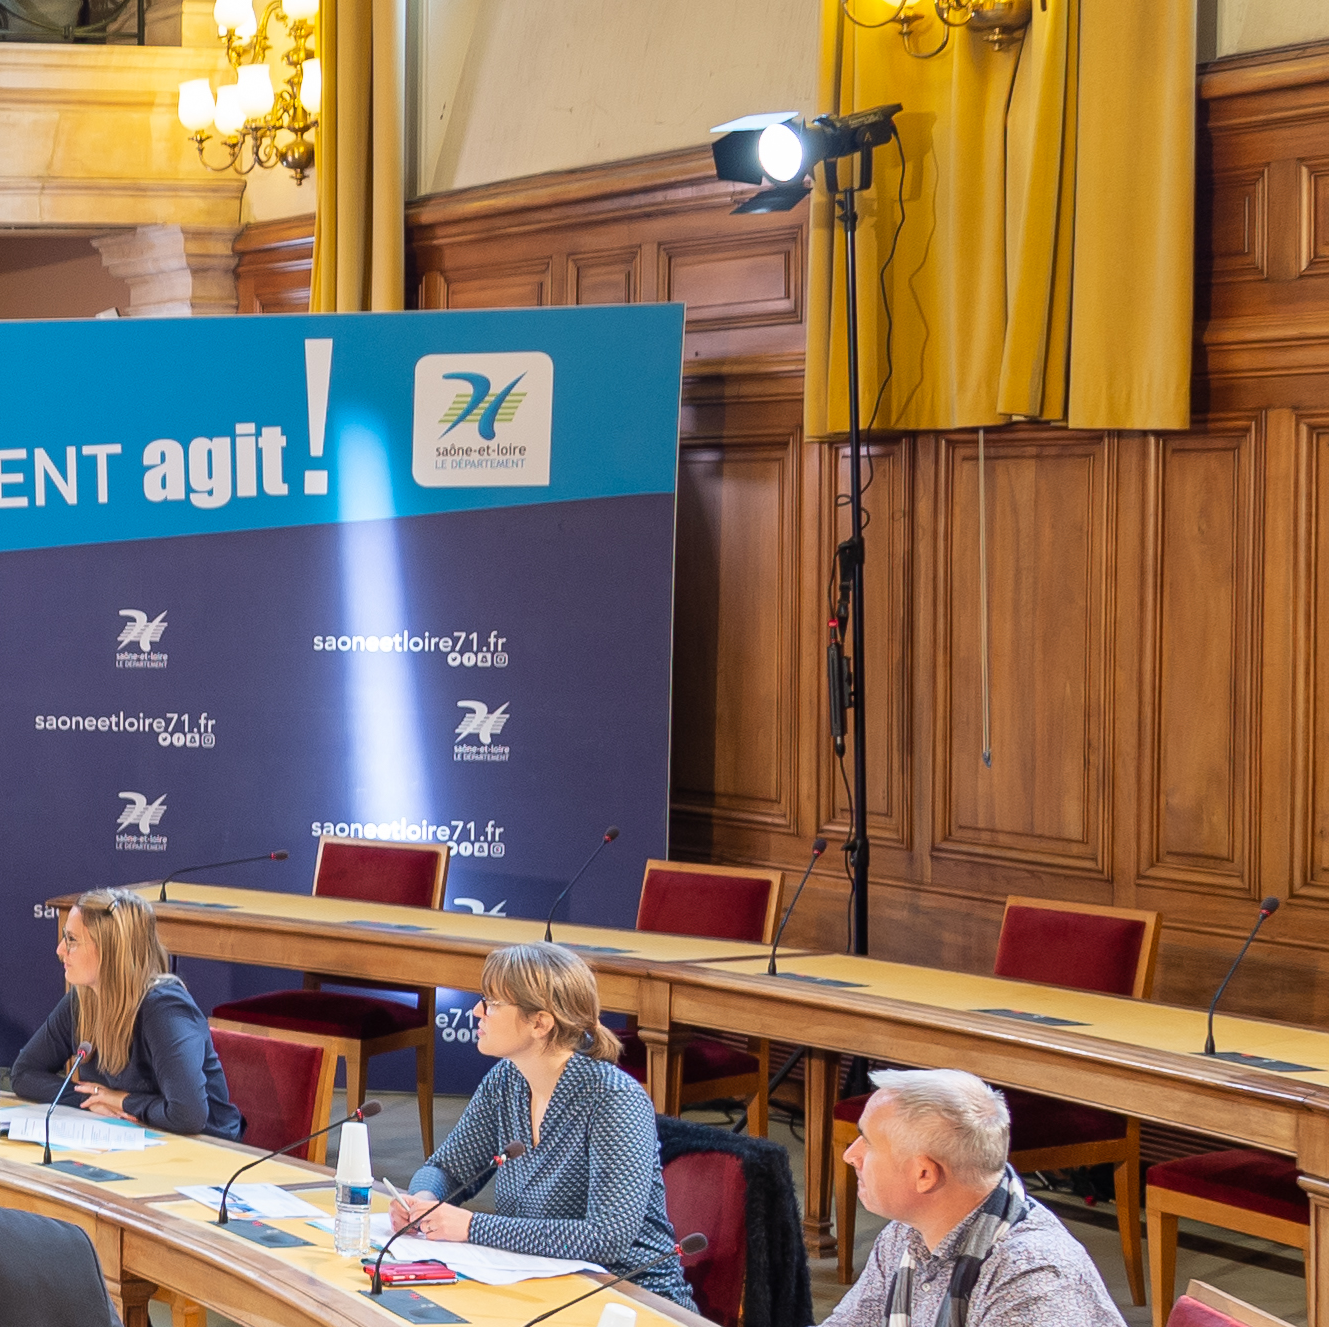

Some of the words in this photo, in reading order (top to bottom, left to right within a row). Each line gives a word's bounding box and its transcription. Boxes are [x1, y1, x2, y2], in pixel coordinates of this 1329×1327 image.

[435, 443, 527, 457] saône-et-loire
[434, 459, 447, 470] LE
[450, 457, 527, 469] DÉPARTEMENT
[313, 630, 507, 652] saoneetloire71.fr
[35, 711, 216, 733] saoneetloire71.fr
[311, 816, 504, 842] saoneetloire71.fr
